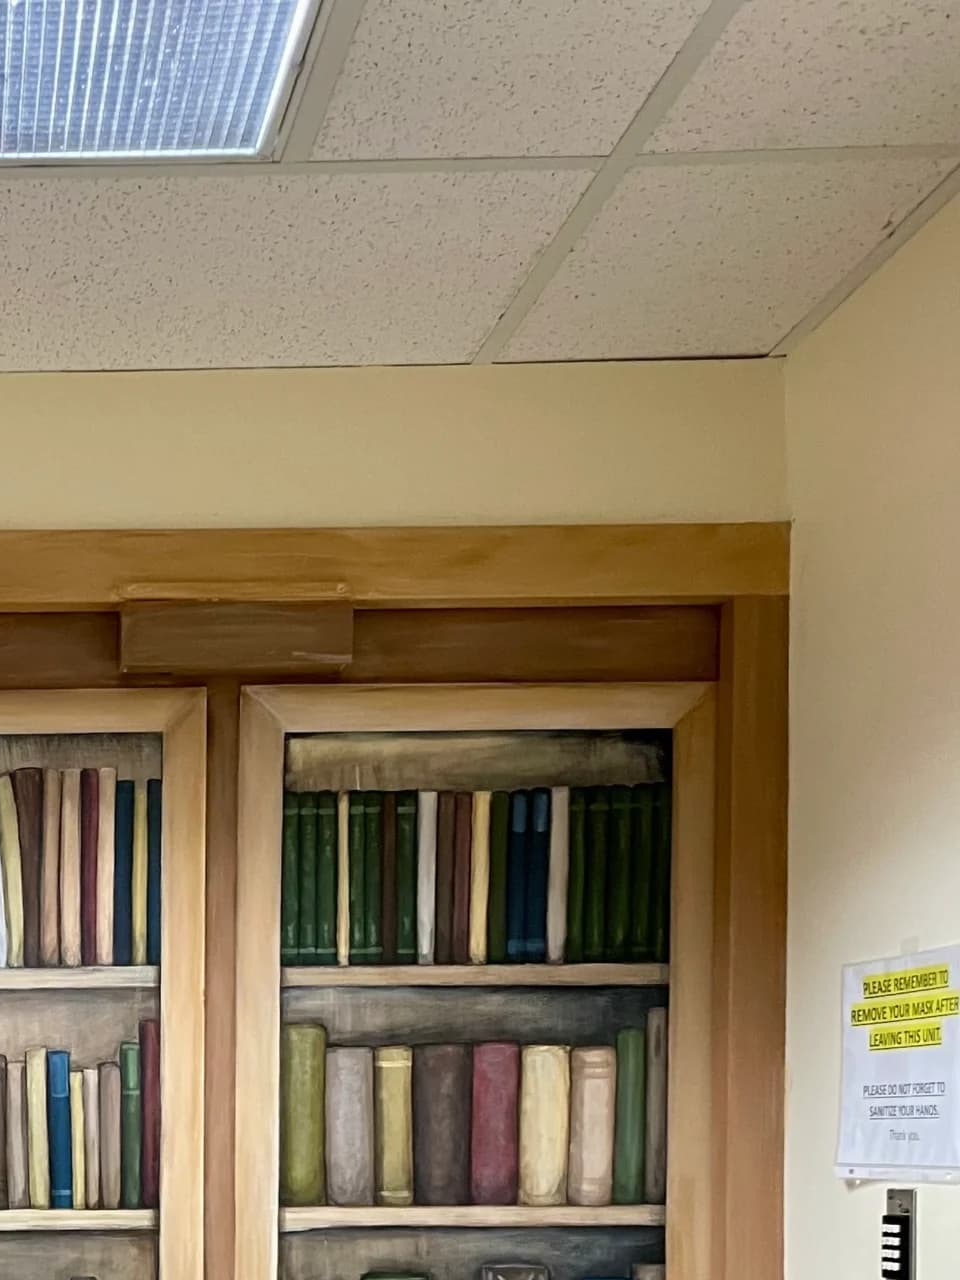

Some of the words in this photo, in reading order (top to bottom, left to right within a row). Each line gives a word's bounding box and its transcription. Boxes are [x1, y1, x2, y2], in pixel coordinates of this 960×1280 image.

[863, 978, 891, 995] PLEASE
[893, 972, 936, 990] REMEMBER
[938, 969, 948, 984] TO
[851, 1006, 887, 1023] REMOVE
[889, 1003, 910, 1019] YOUR
[912, 1000, 933, 1016] MASK
[935, 996, 959, 1013] AFTER
[869, 1031, 902, 1047] LEAVING
[903, 1029, 921, 1044] THIS
[863, 1085, 887, 1097] PLEASE
[888, 1084, 897, 1095] DO
[898, 1083, 911, 1094] NOT
[912, 1082, 935, 1094] FORGET
[936, 1081, 945, 1093] TO
[869, 1105, 897, 1117] SANITIZE
[898, 1105, 914, 1116] YOUR
